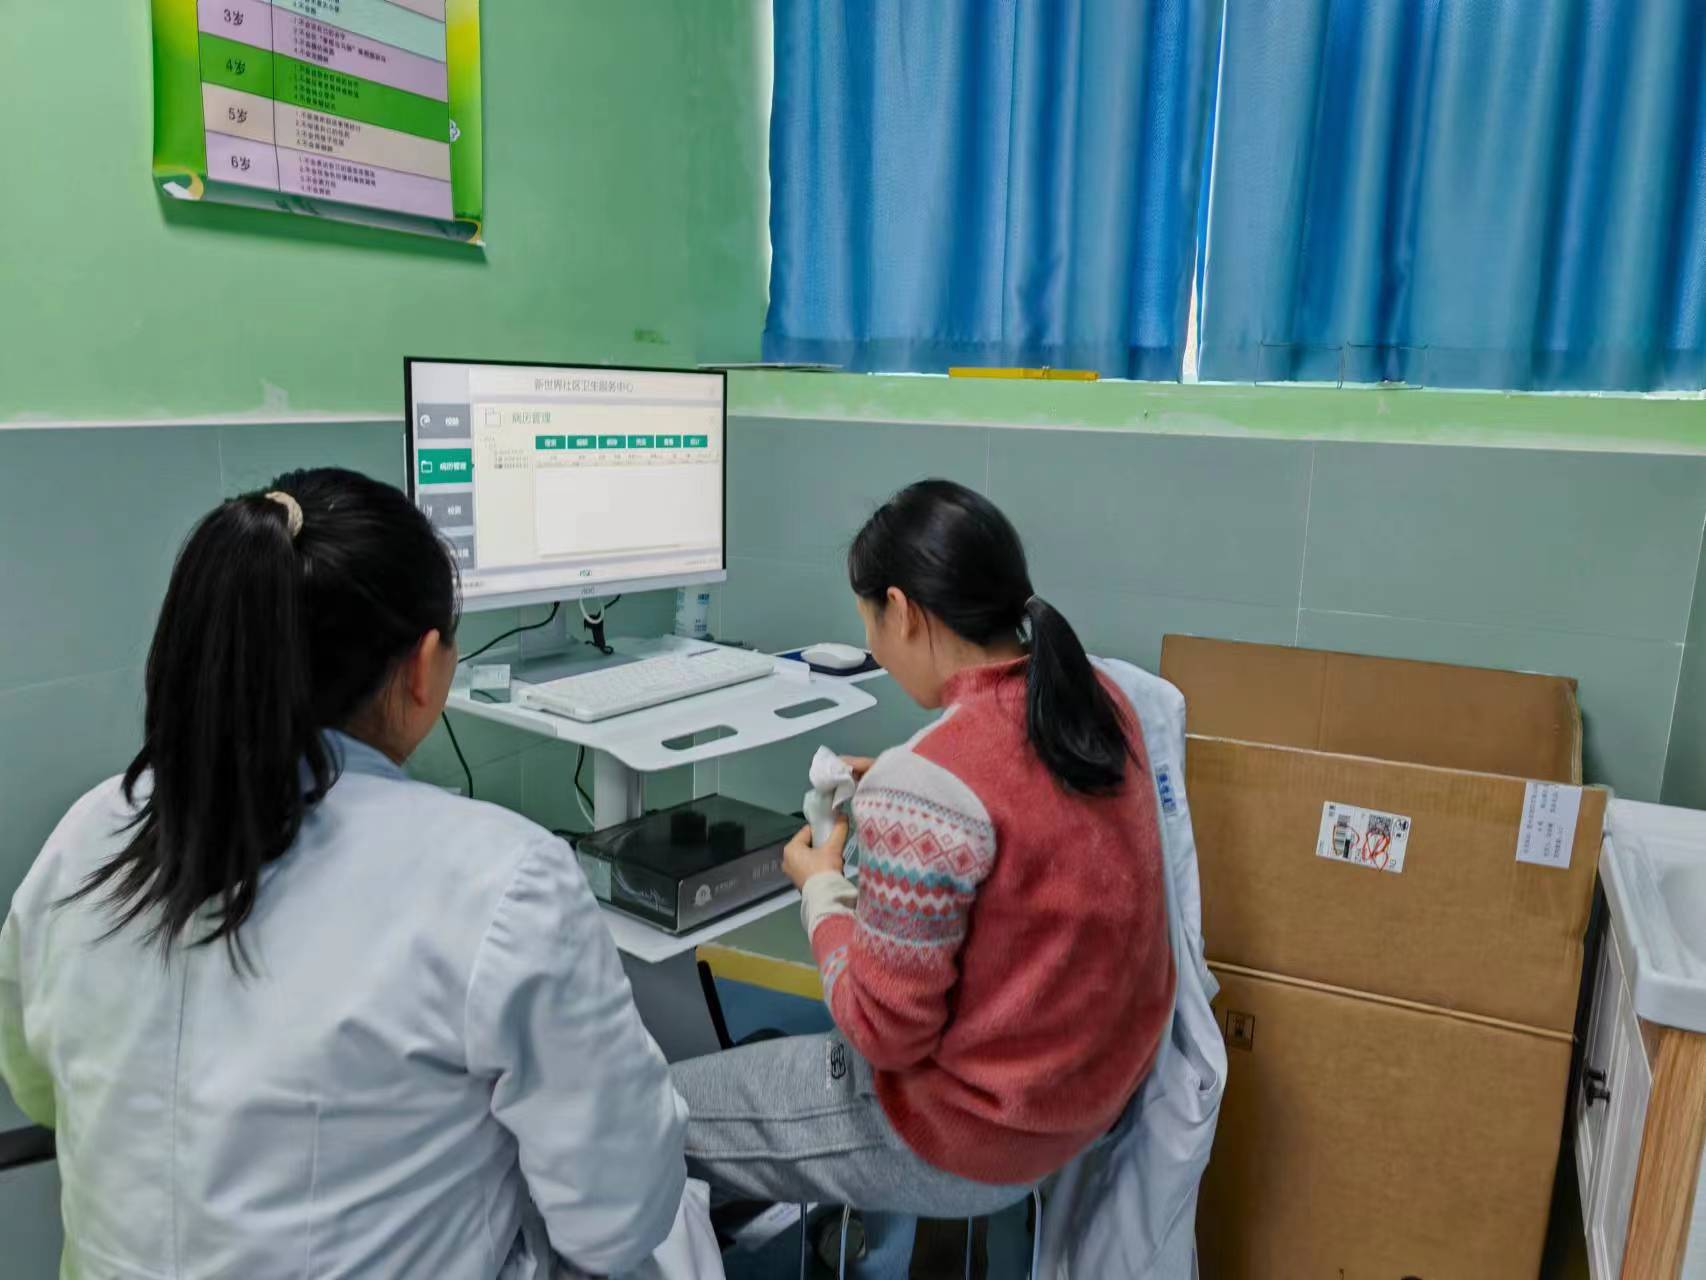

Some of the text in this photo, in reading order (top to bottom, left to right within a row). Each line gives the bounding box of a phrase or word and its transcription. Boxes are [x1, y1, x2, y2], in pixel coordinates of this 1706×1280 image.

[224, 8, 244, 26] 3岁
[225, 58, 246, 75] 4岁
[228, 107, 248, 123] 5岁
[231, 155, 251, 171] 6岁
[534, 377, 635, 393] 新世界社区卫生服务中心
